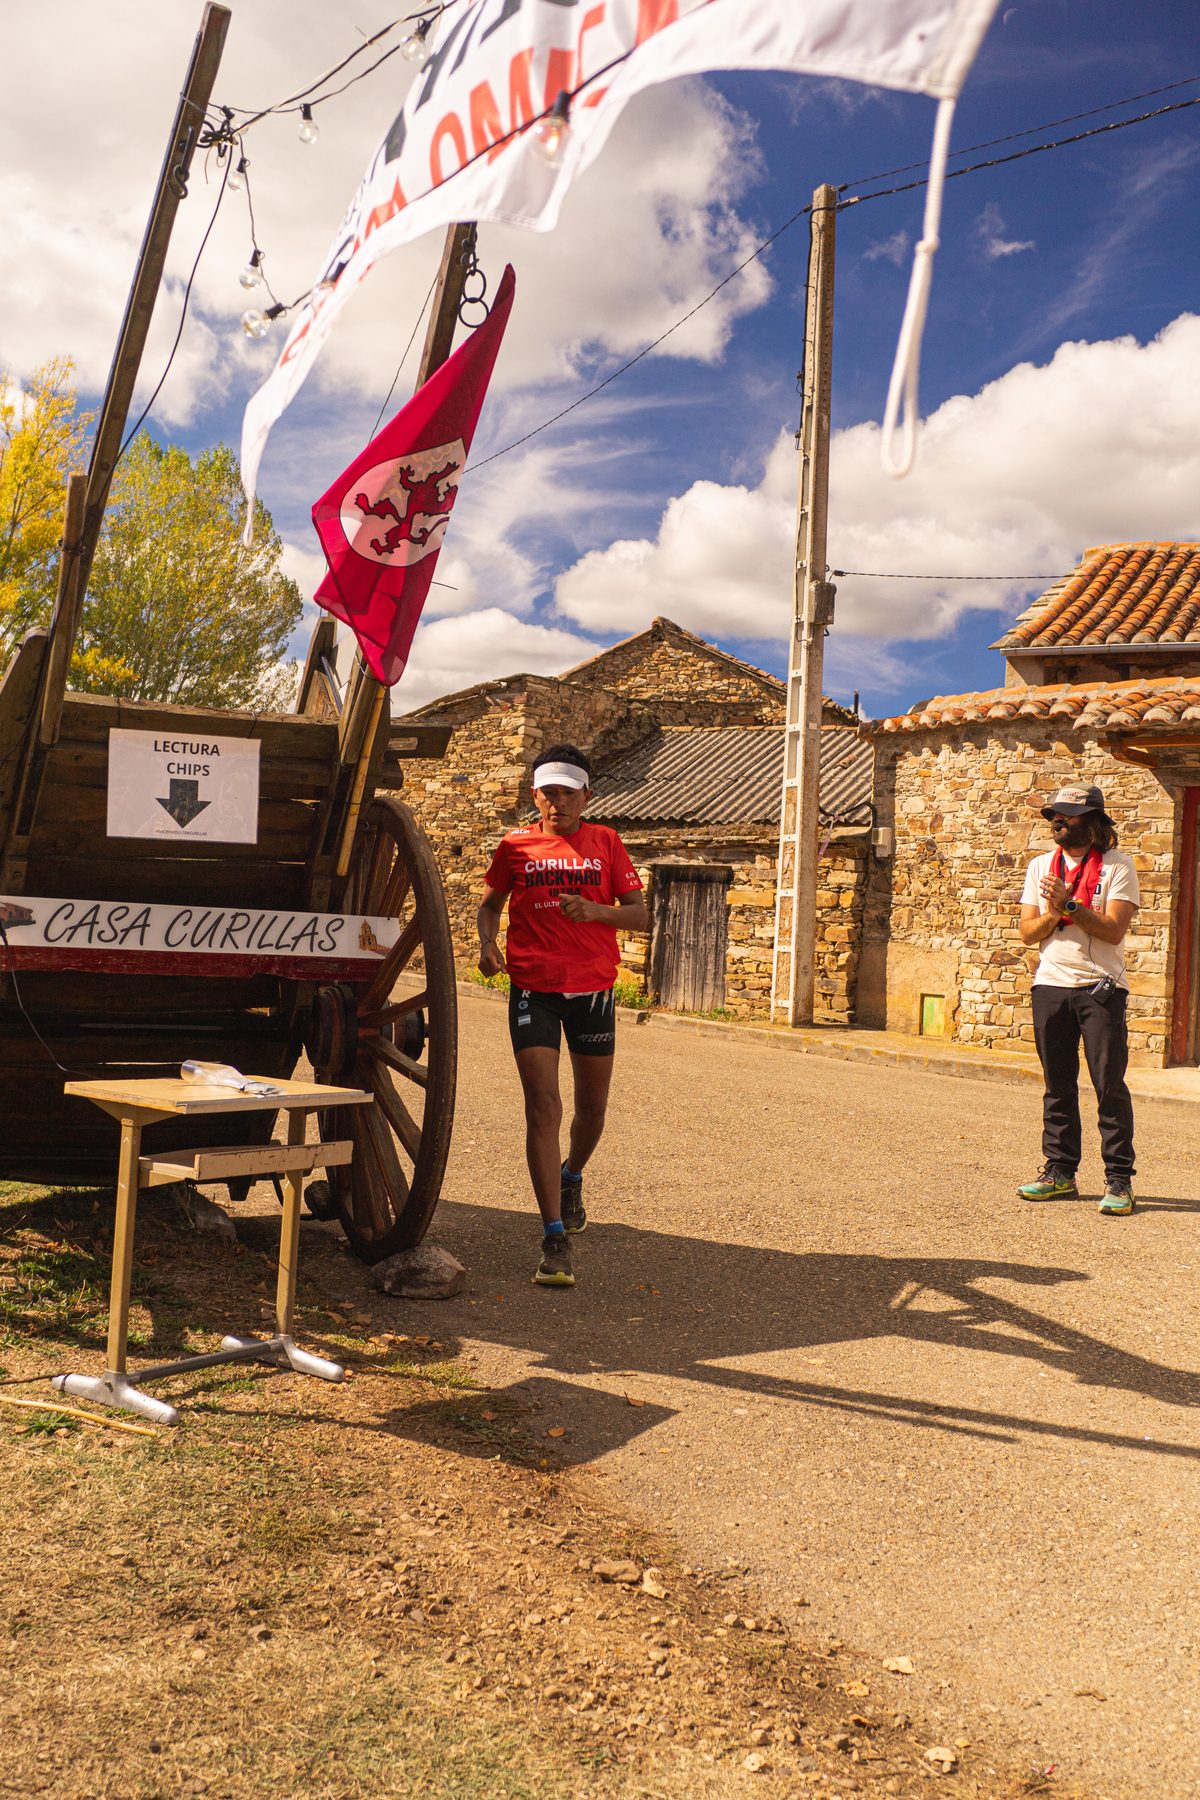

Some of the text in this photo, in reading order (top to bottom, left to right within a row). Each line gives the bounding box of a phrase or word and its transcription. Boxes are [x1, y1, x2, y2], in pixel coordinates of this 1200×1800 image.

[153, 740, 221, 757] LECTURA
[166, 762, 211, 777] CHIPS
[525, 858, 601, 873] CURILLAS
[525, 870, 601, 889] BACKYARD
[43, 902, 345, 952] CASA CURILLAS
